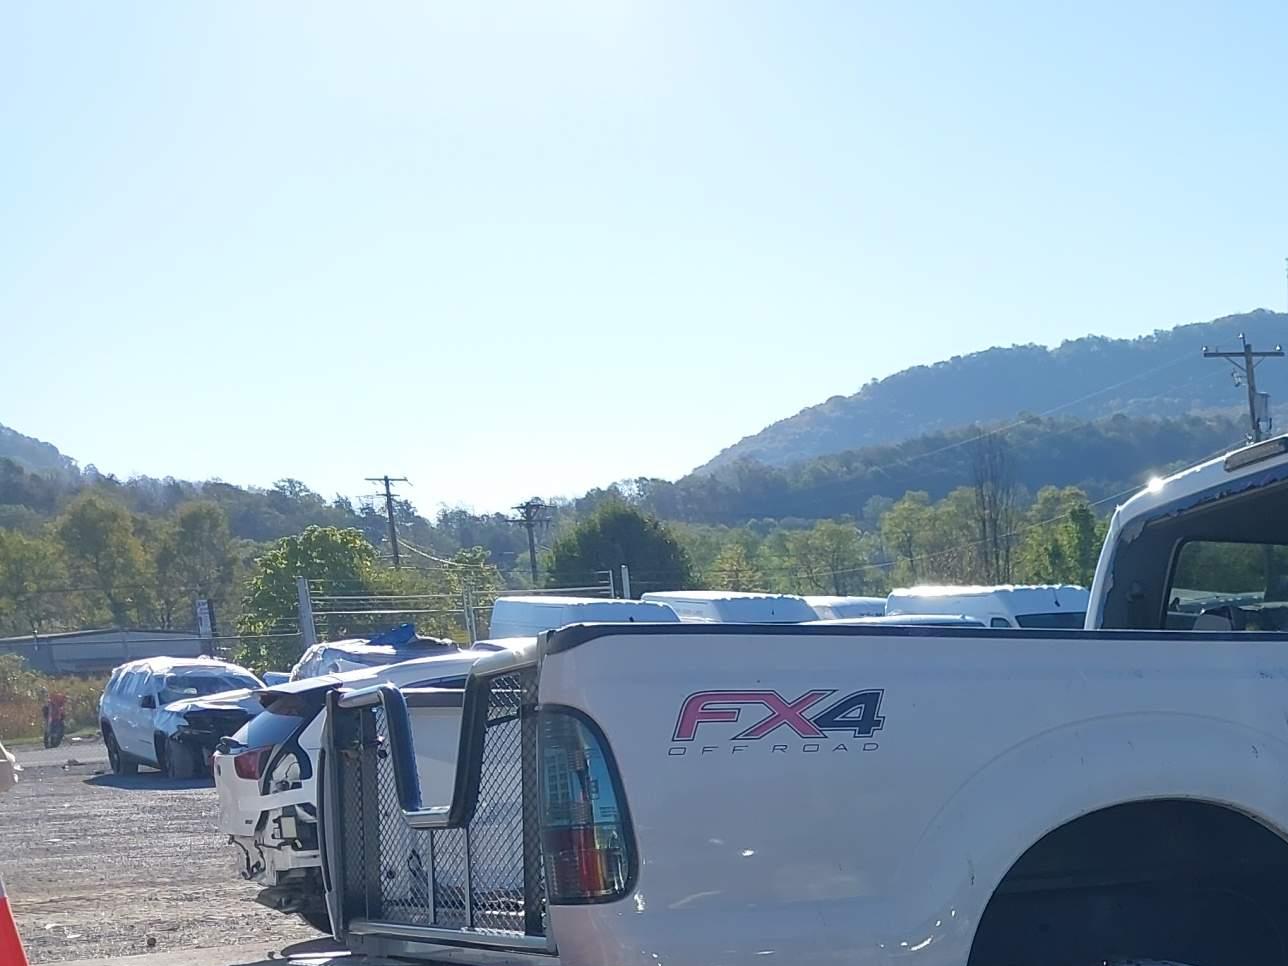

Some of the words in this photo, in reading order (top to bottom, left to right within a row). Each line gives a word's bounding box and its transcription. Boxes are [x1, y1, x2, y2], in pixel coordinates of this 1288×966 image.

[671, 688, 886, 742] FX4
[668, 745, 750, 756] OFF
[771, 742, 880, 754] ROAD
